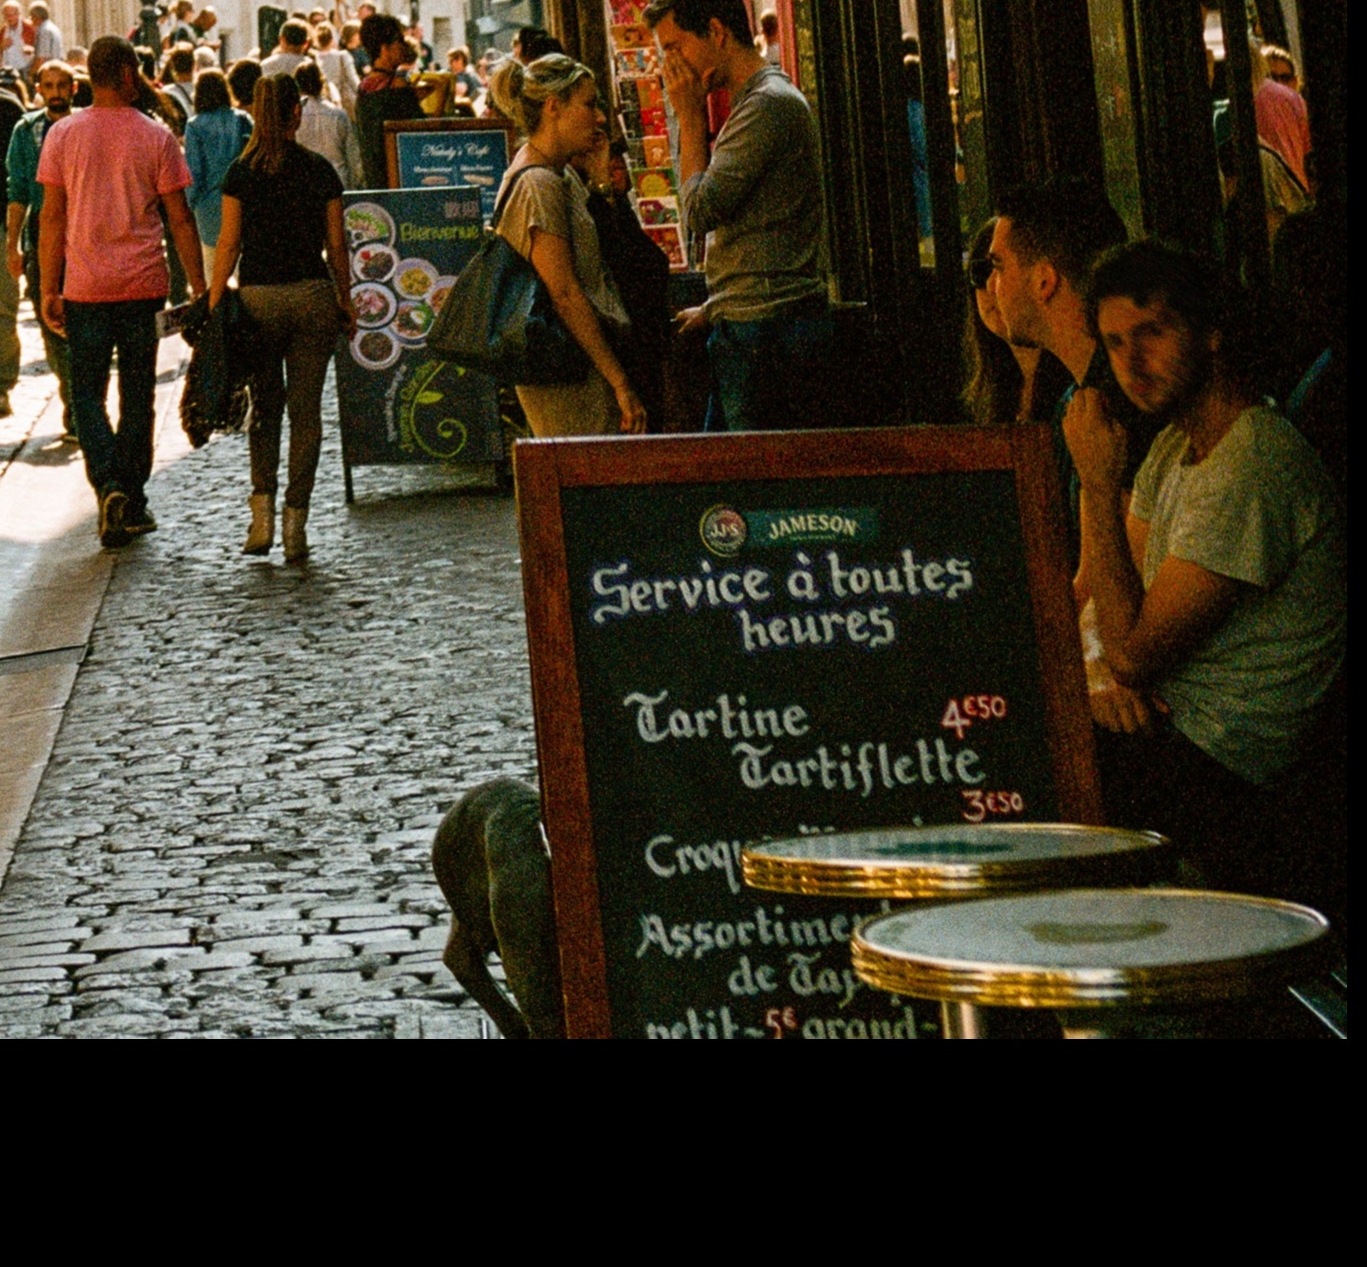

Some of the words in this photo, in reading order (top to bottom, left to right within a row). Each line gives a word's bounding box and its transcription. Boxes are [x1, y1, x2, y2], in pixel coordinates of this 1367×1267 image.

[400, 222, 480, 242] Bienvenue
[768, 513, 862, 540] JAMESON
[591, 558, 770, 625] Service
[787, 548, 819, 602] à
[827, 547, 974, 602] toutes
[738, 602, 898, 652] heures
[623, 689, 810, 744] Tartine
[732, 738, 988, 798] Tartiflette
[728, 955, 779, 997] de
[786, 951, 858, 1009] Tap
